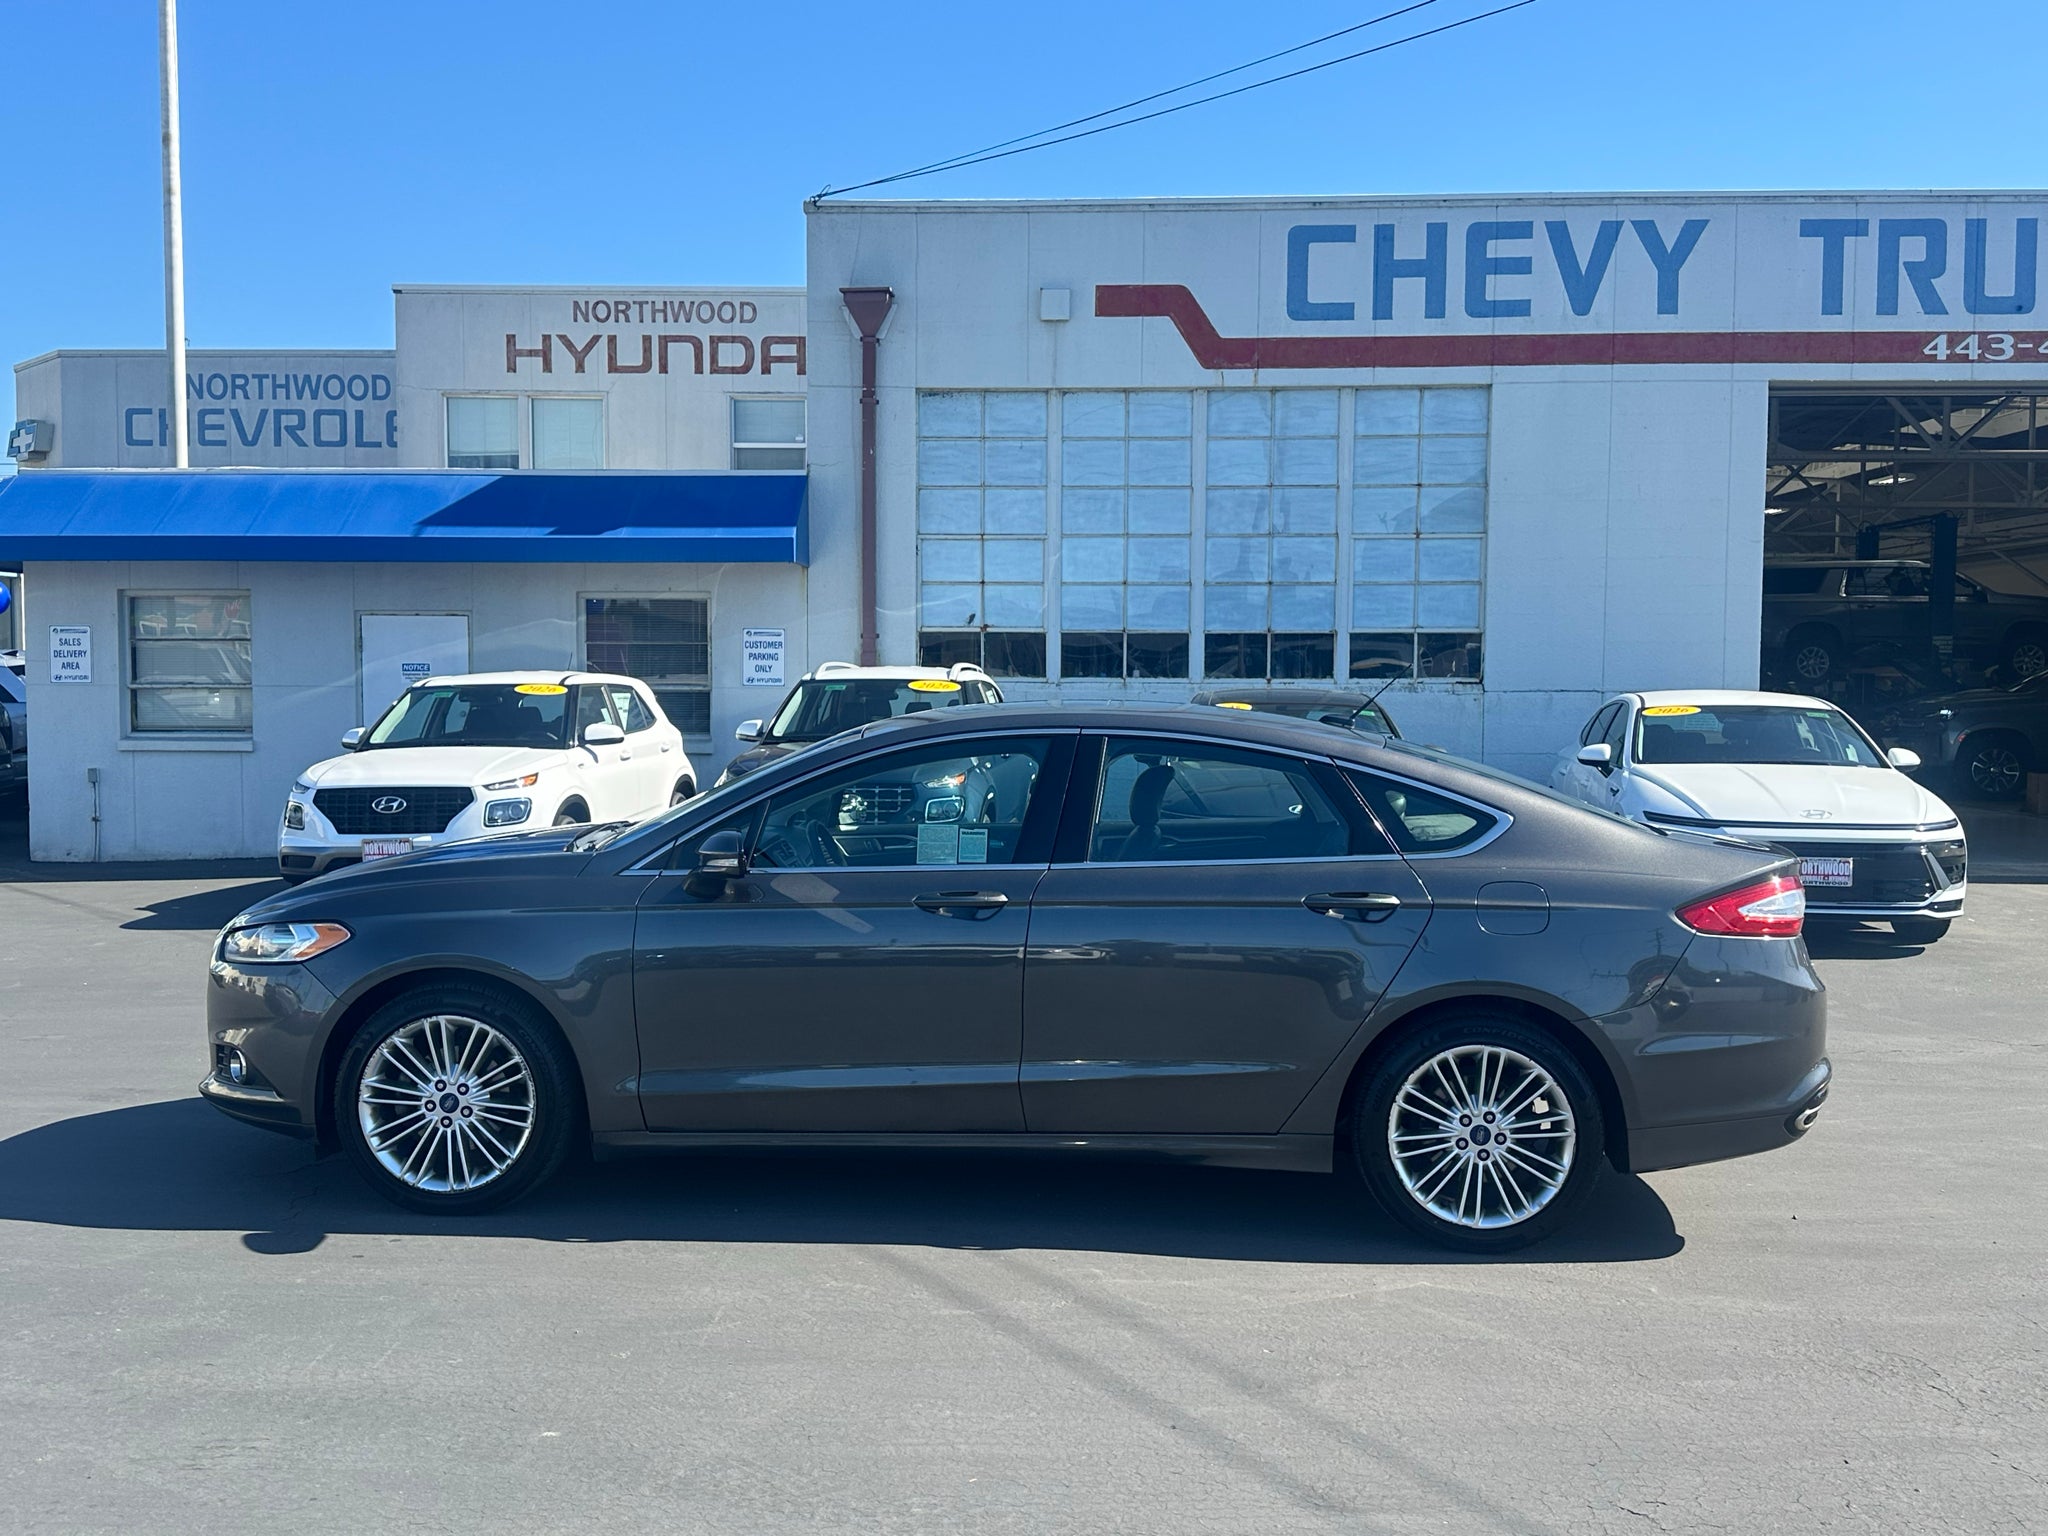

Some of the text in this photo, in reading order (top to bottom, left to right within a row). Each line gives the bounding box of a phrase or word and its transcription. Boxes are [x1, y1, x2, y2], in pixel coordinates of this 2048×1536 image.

[1287, 218, 2038, 321] CHEVY TRU
[572, 300, 757, 324] NORTHWOOD
[505, 333, 806, 375] HYUNDA
[186, 373, 392, 400] NORTHWOOD
[59, 638, 82, 646] SALES
[744, 641, 783, 649] CUSTOMER
[53, 650, 87, 658] DELIVERY
[748, 653, 779, 661] PARKING
[61, 662, 80, 670] AREA
[754, 664, 773, 673] ONLY
[364, 842, 410, 854] NORTHWOOD
[1801, 862, 1850, 875] ORTHWOOD
